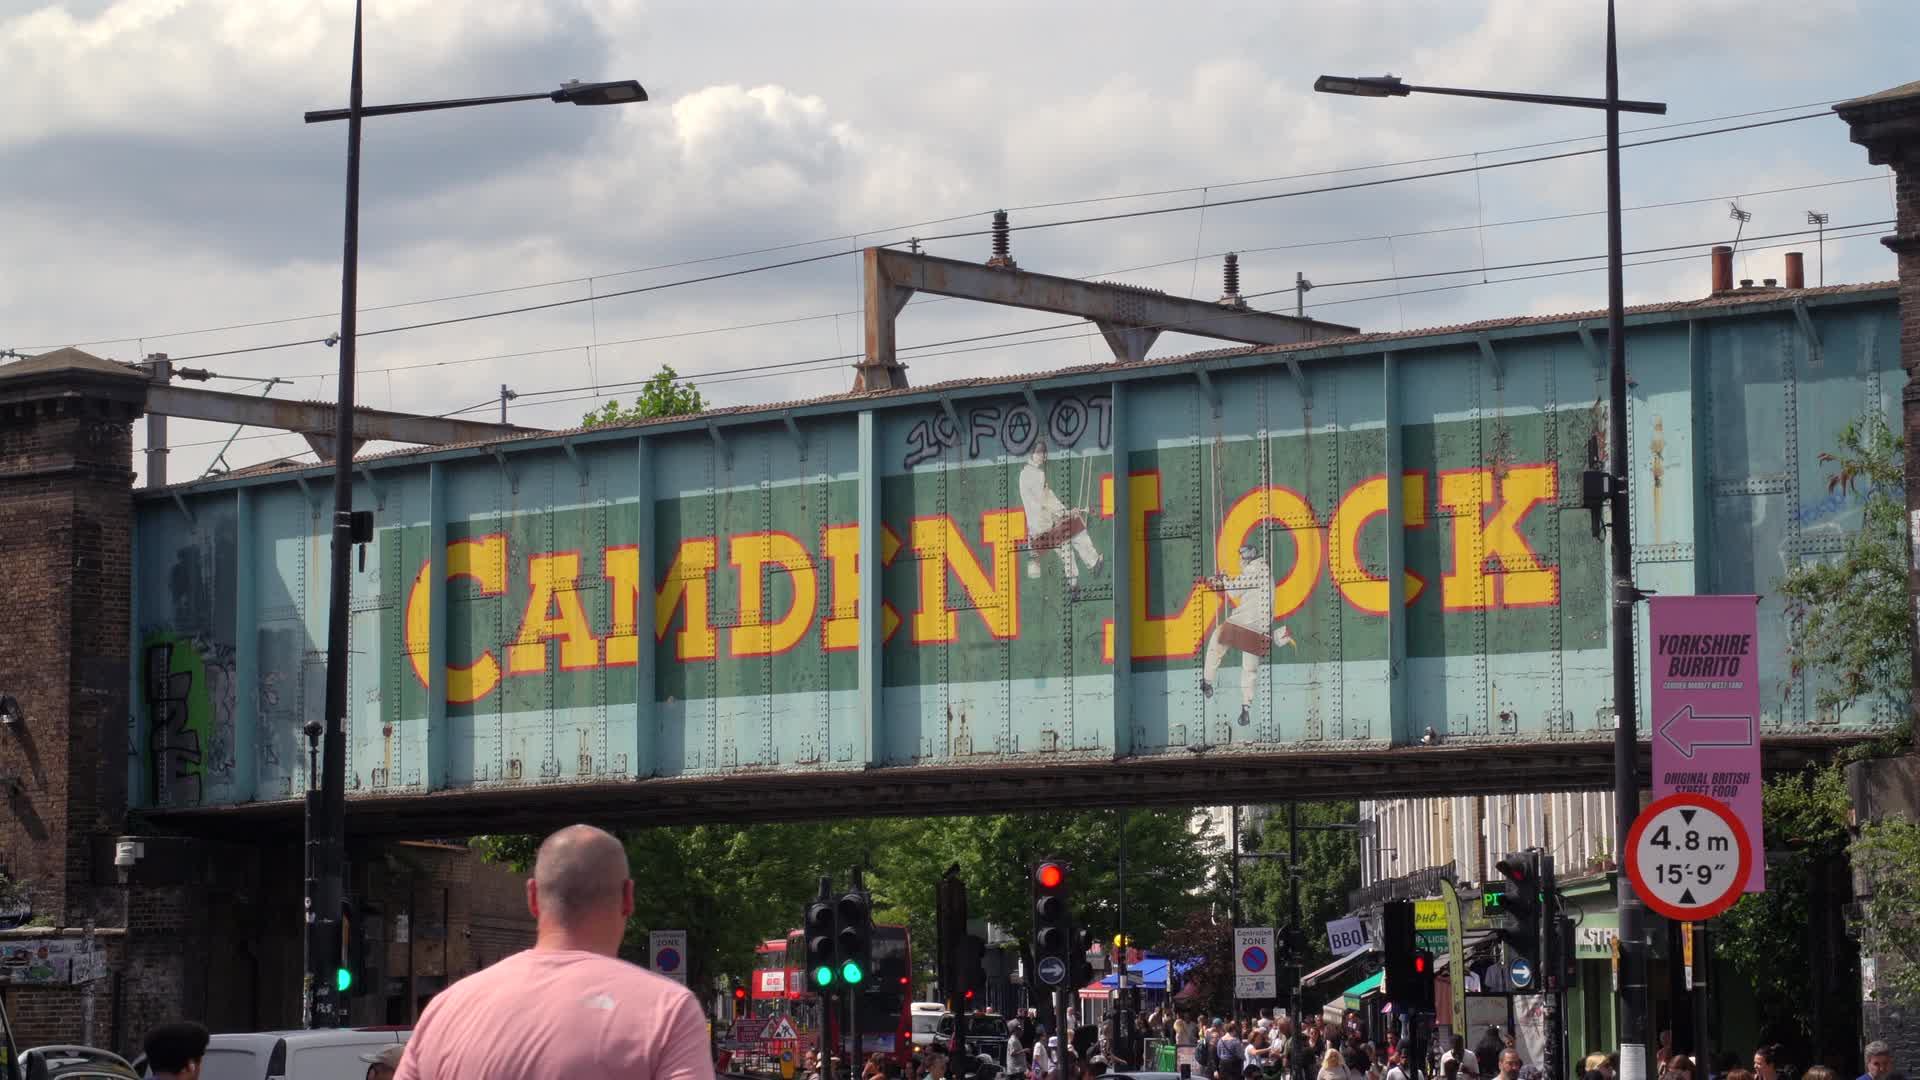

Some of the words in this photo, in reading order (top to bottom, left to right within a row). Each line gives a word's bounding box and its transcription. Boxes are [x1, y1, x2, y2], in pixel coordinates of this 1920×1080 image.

[404, 507, 1029, 705] CAMDEN
[1100, 463, 1559, 664] LOCK
[1658, 634, 1751, 655] YORKSHIRE
[1667, 656, 1740, 677] BURRITO
[1663, 772, 1708, 784] ORIGINAL
[1711, 772, 1750, 784] BRITISH
[1711, 785, 1738, 797] FOOD
[1650, 825, 1700, 851] 4.8
[1707, 835, 1729, 851] m
[1242, 937, 1268, 945] ZONE
[1332, 929, 1363, 949] BBQ
